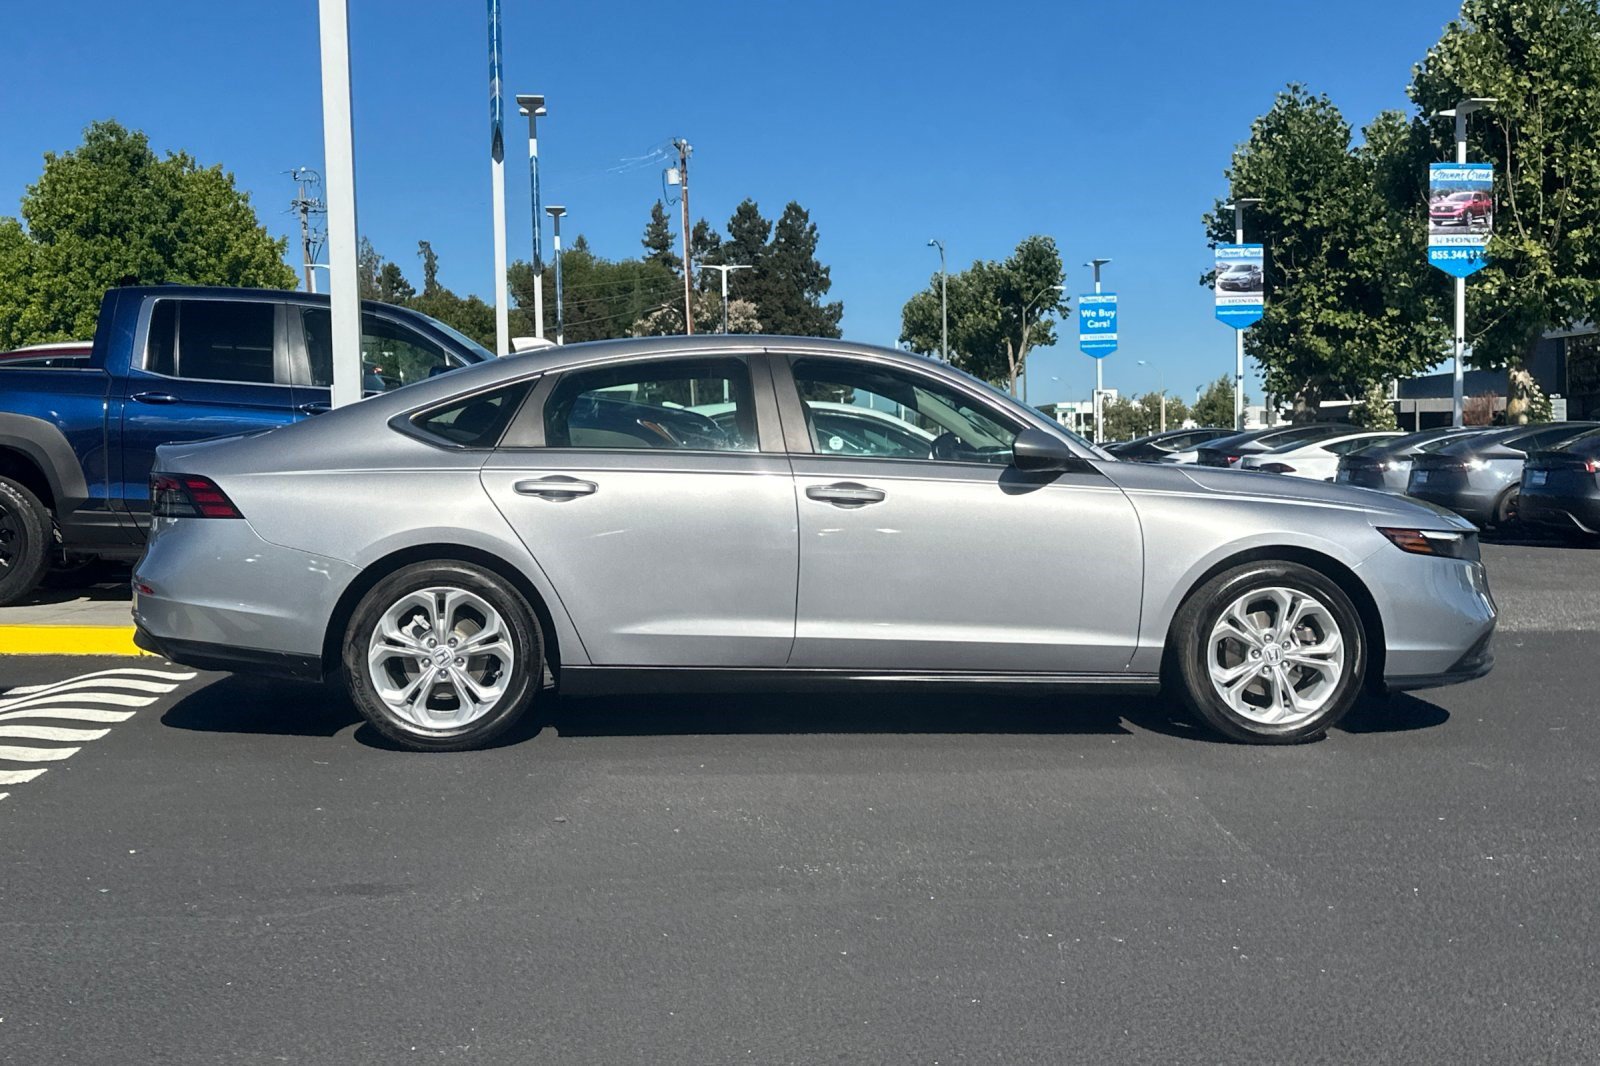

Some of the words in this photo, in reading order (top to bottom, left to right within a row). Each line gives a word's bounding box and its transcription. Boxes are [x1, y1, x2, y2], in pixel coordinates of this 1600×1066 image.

[1467, 169, 1491, 181] Creek
[1081, 309, 1097, 318] We
[1098, 308, 1116, 319] Buy
[1087, 320, 1110, 328] Cars!
